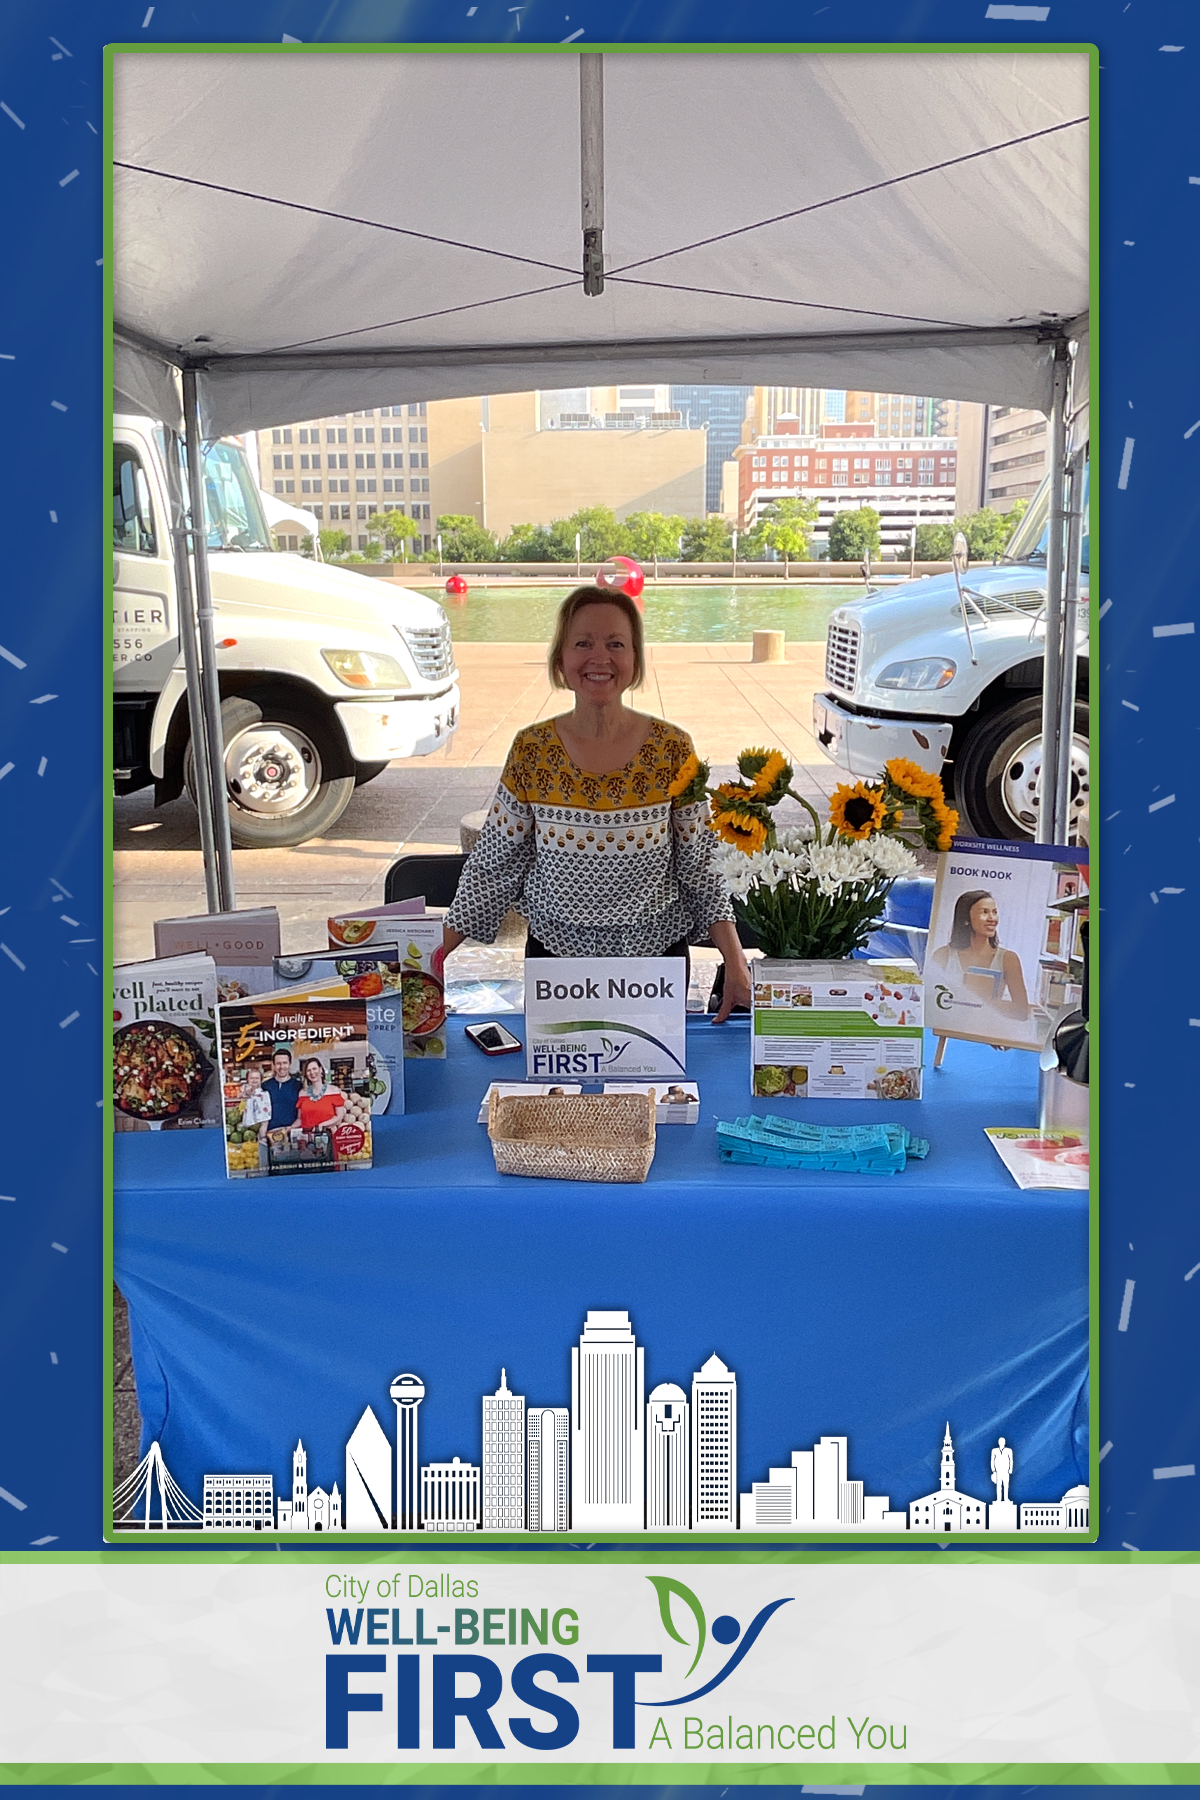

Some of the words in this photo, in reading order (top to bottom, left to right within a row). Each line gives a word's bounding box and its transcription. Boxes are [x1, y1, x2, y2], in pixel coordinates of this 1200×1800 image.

[953, 841, 985, 850] WORKSITE
[986, 843, 1020, 853] WELLNESS
[950, 866, 979, 877] BOOK
[981, 869, 1012, 880] NOOK
[536, 978, 600, 1000] Book
[608, 977, 674, 999] Nook
[134, 993, 203, 1020] plated
[235, 1021, 262, 1062] 5
[259, 1026, 355, 1042] INGREDIENT
[533, 1044, 587, 1053] WELL-BEING
[533, 1053, 604, 1075] FIRST
[608, 1065, 642, 1073] Balanced
[643, 1065, 656, 1073] You
